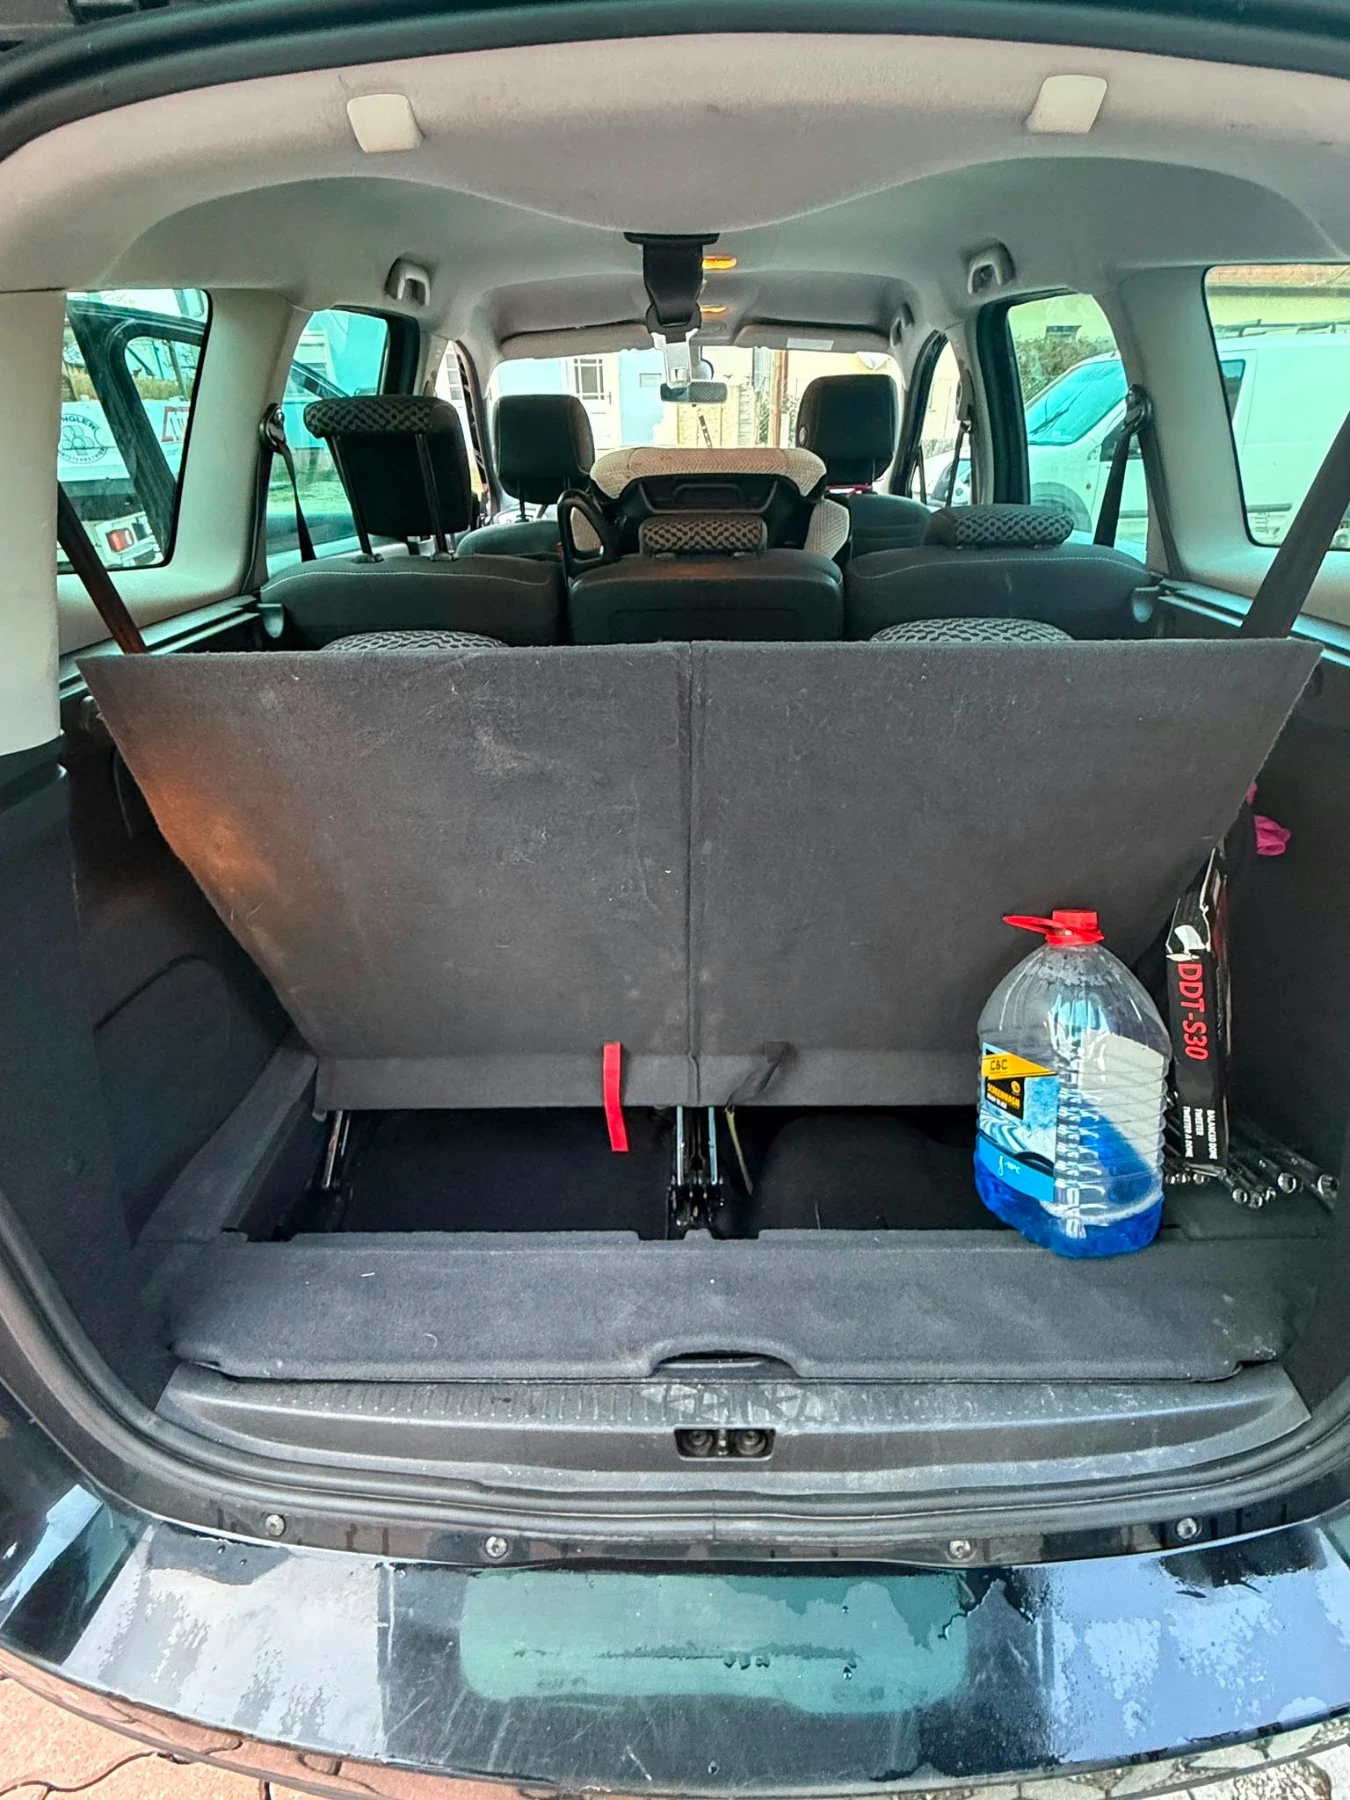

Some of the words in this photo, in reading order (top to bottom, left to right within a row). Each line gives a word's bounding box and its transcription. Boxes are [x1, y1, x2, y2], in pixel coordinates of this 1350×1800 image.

[990, 1059, 1008, 1071] C&C
[1182, 1106, 1192, 1134] TWEETER
[1194, 1108, 1204, 1136] TWEETER
